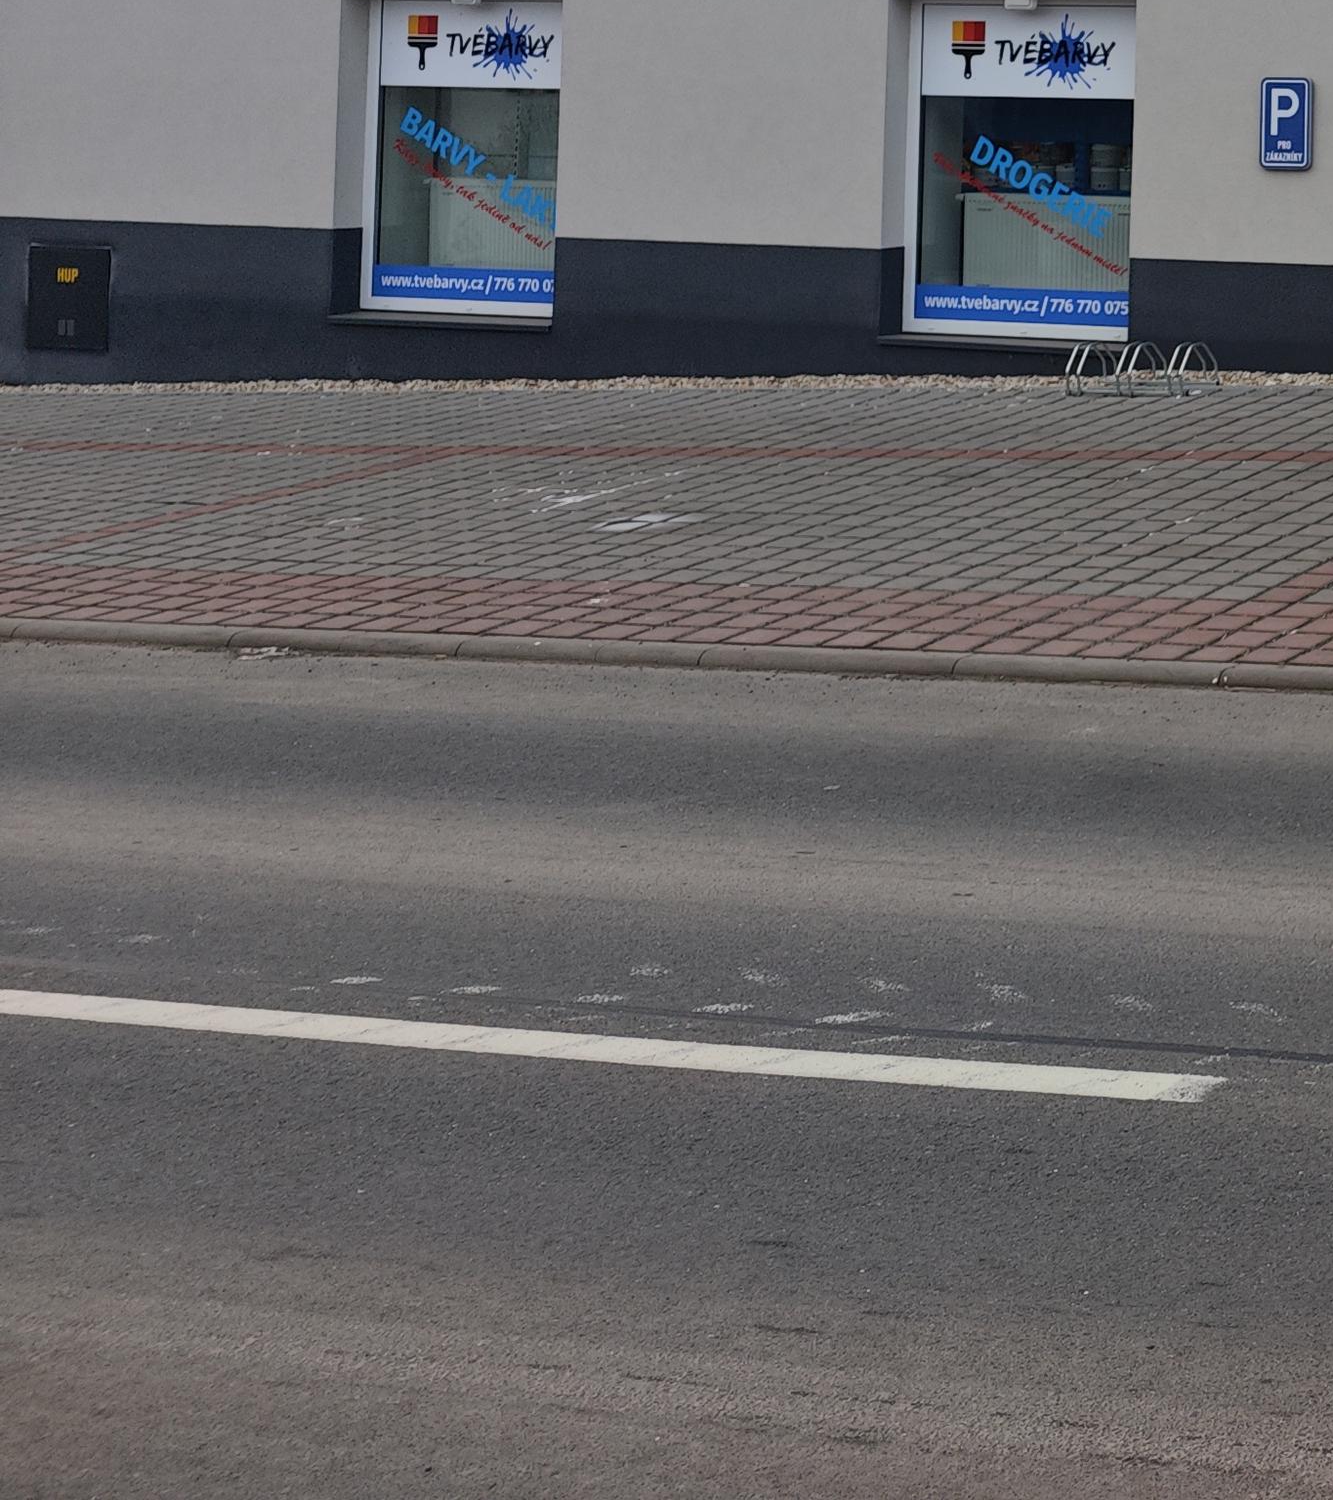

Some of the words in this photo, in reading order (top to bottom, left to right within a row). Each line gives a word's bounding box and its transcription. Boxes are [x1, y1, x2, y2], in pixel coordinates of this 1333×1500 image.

[446, 27, 555, 59] TVÉBARVY
[994, 33, 1116, 68] TVÉBARVY
[1269, 87, 1300, 136] P
[1277, 140, 1292, 150] PRO
[400, 106, 487, 177] BARVY
[500, 174, 556, 230] LAK
[969, 135, 1113, 239] DROGERIE
[508, 221, 527, 234] od
[57, 267, 79, 283] HUP
[381, 274, 484, 293] www.tvebarvy.cz
[494, 276, 515, 291] 776
[517, 277, 540, 292] 770
[924, 294, 1039, 315] www.tvebarvy.cz
[1050, 298, 1074, 313] 776
[1076, 299, 1101, 315] 770
[1104, 300, 1128, 315] 075
